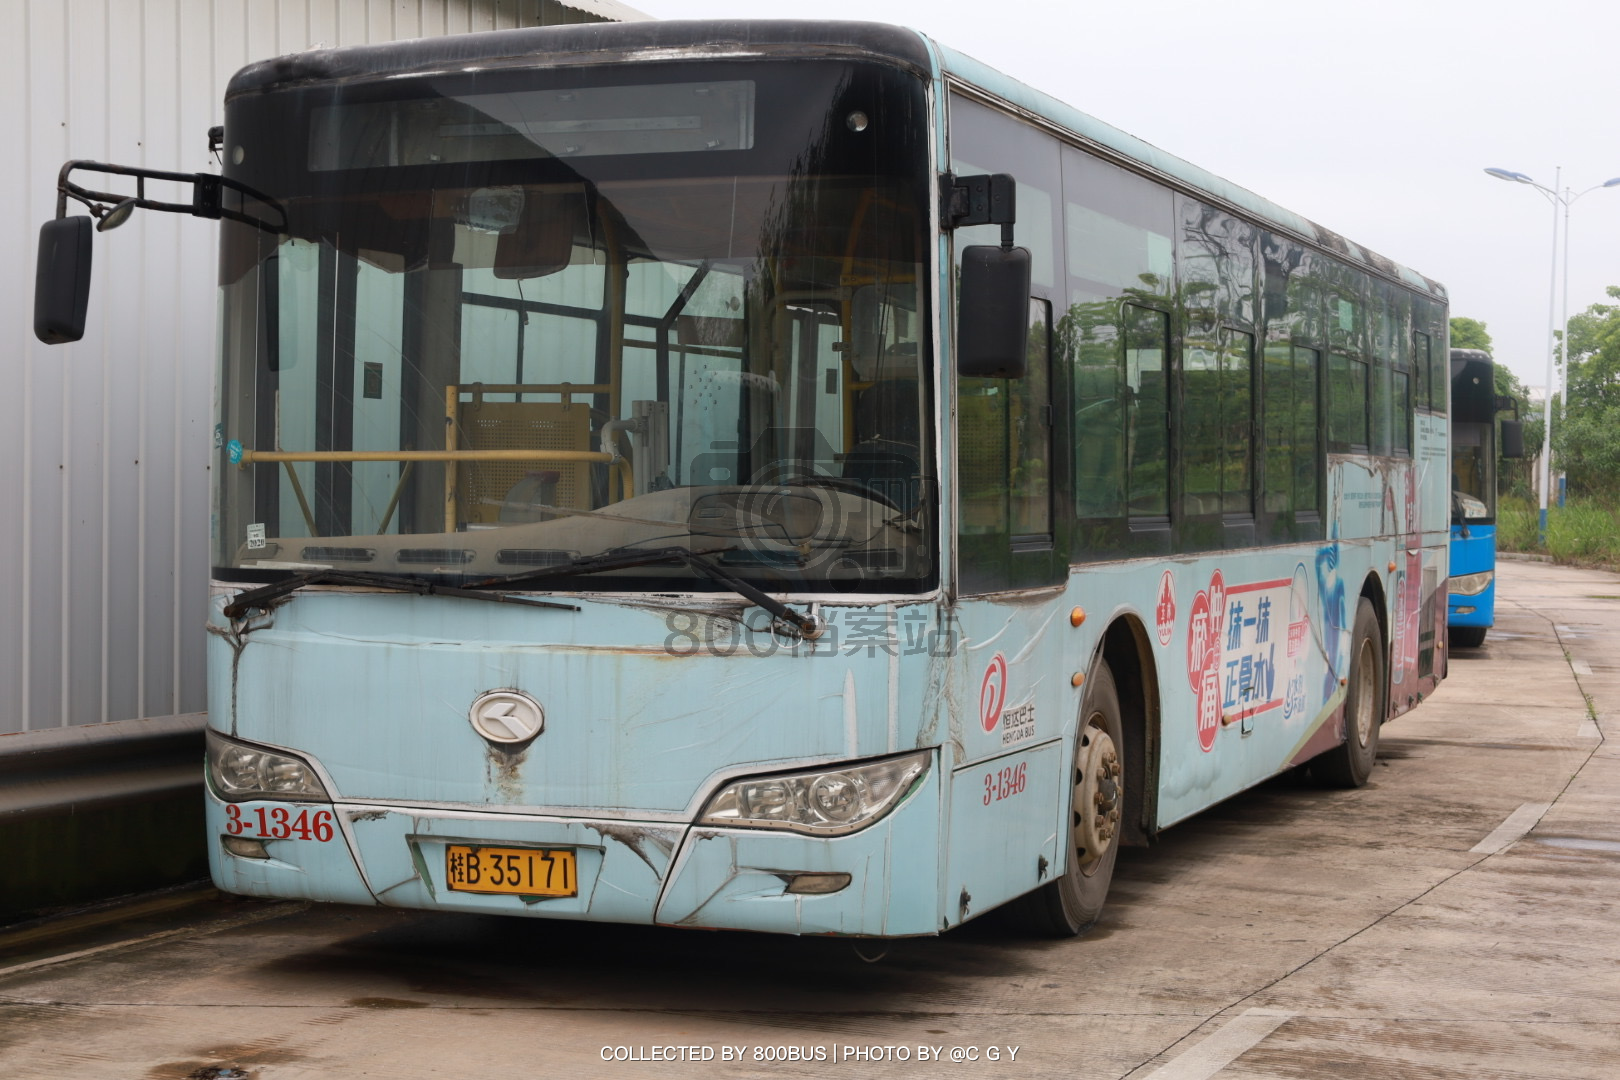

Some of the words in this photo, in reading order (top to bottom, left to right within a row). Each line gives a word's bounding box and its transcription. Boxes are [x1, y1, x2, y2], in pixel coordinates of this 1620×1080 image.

[1227, 596, 1271, 651] 抹一抹
[1223, 652, 1266, 709] 正骨水
[1025, 725, 1035, 738] BUS
[983, 762, 1027, 806] 3-1346
[226, 804, 334, 842] 3-1346
[450, 853, 568, 889] 桂B·35171
